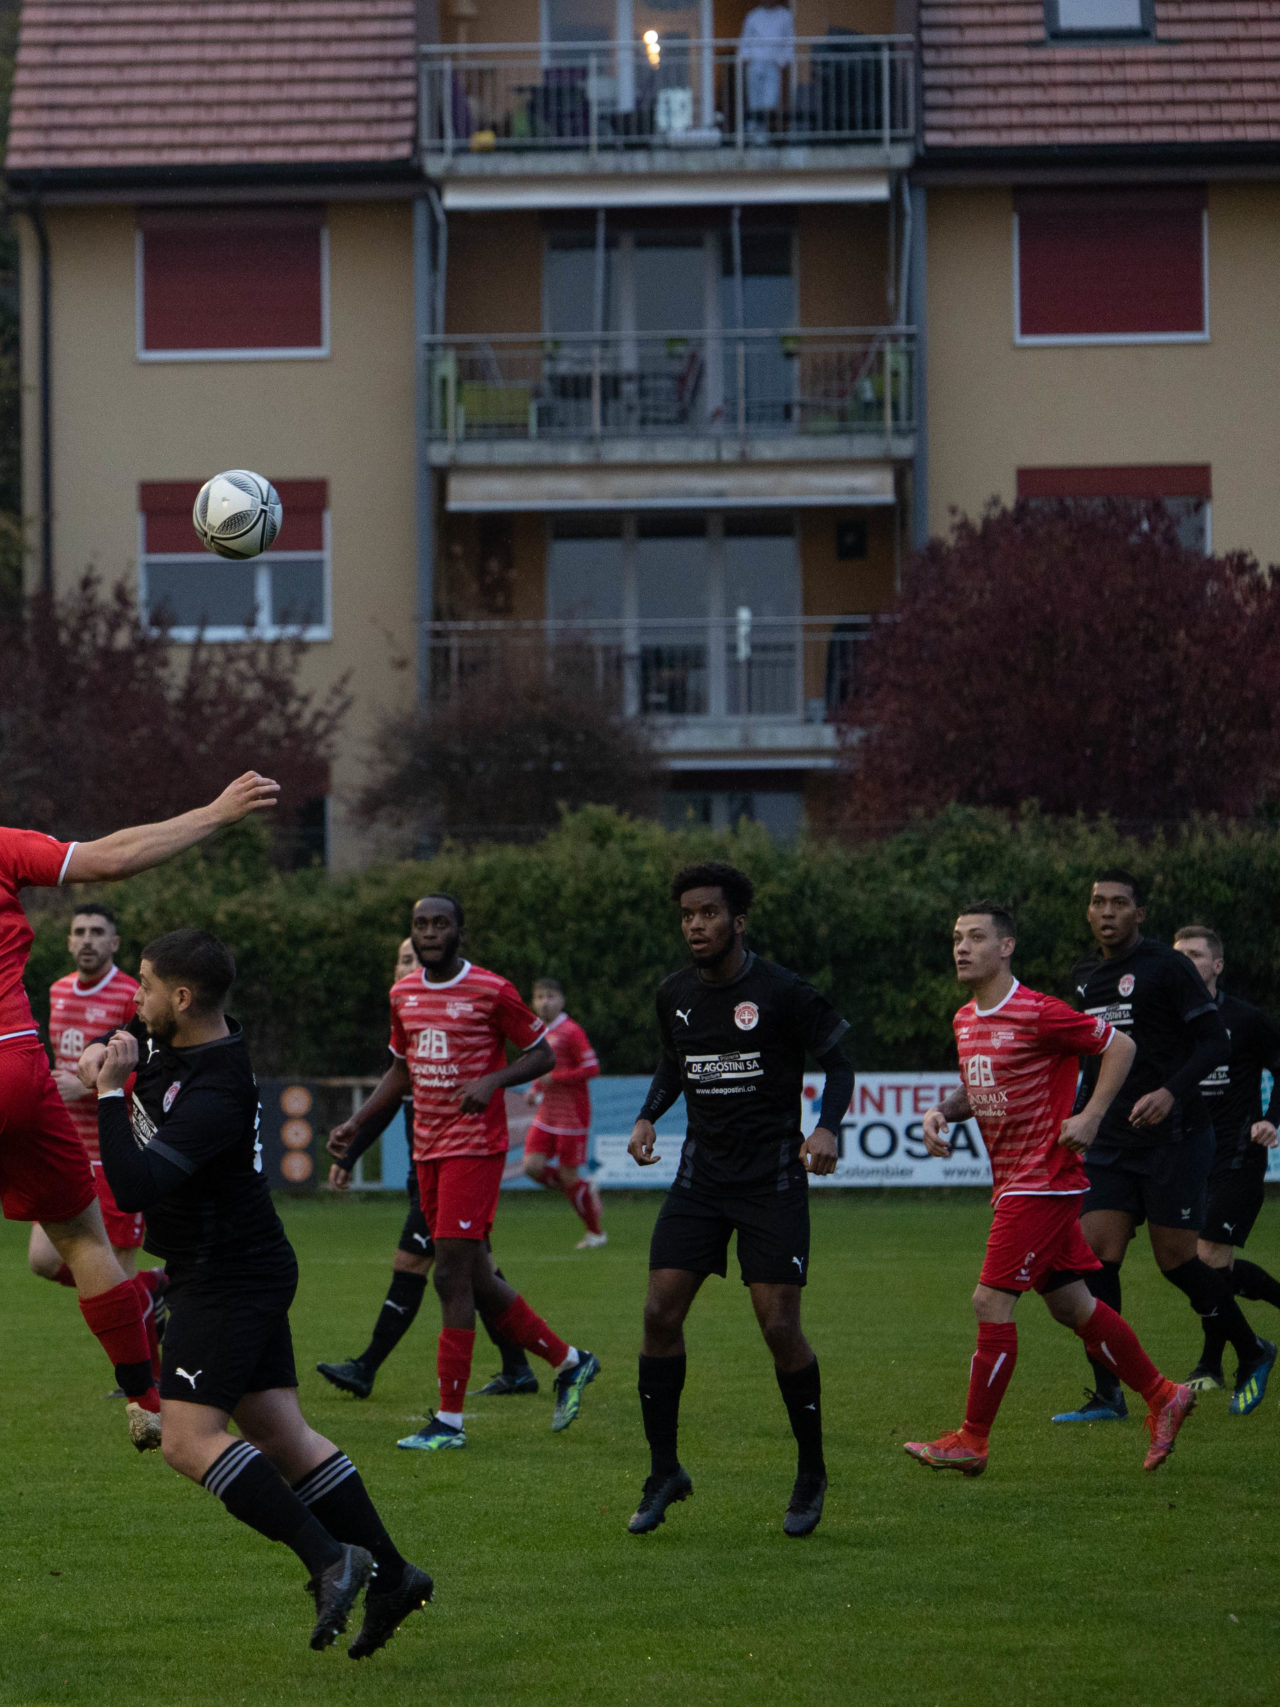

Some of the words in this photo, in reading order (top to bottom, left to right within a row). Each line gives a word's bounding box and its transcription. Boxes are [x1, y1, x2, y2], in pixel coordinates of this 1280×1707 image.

[692, 1063, 702, 1072] DE
[702, 1061, 745, 1073] AGOSTINI
[746, 1060, 760, 1070] SA
[695, 1085, 757, 1096] www.deagostini.ch
